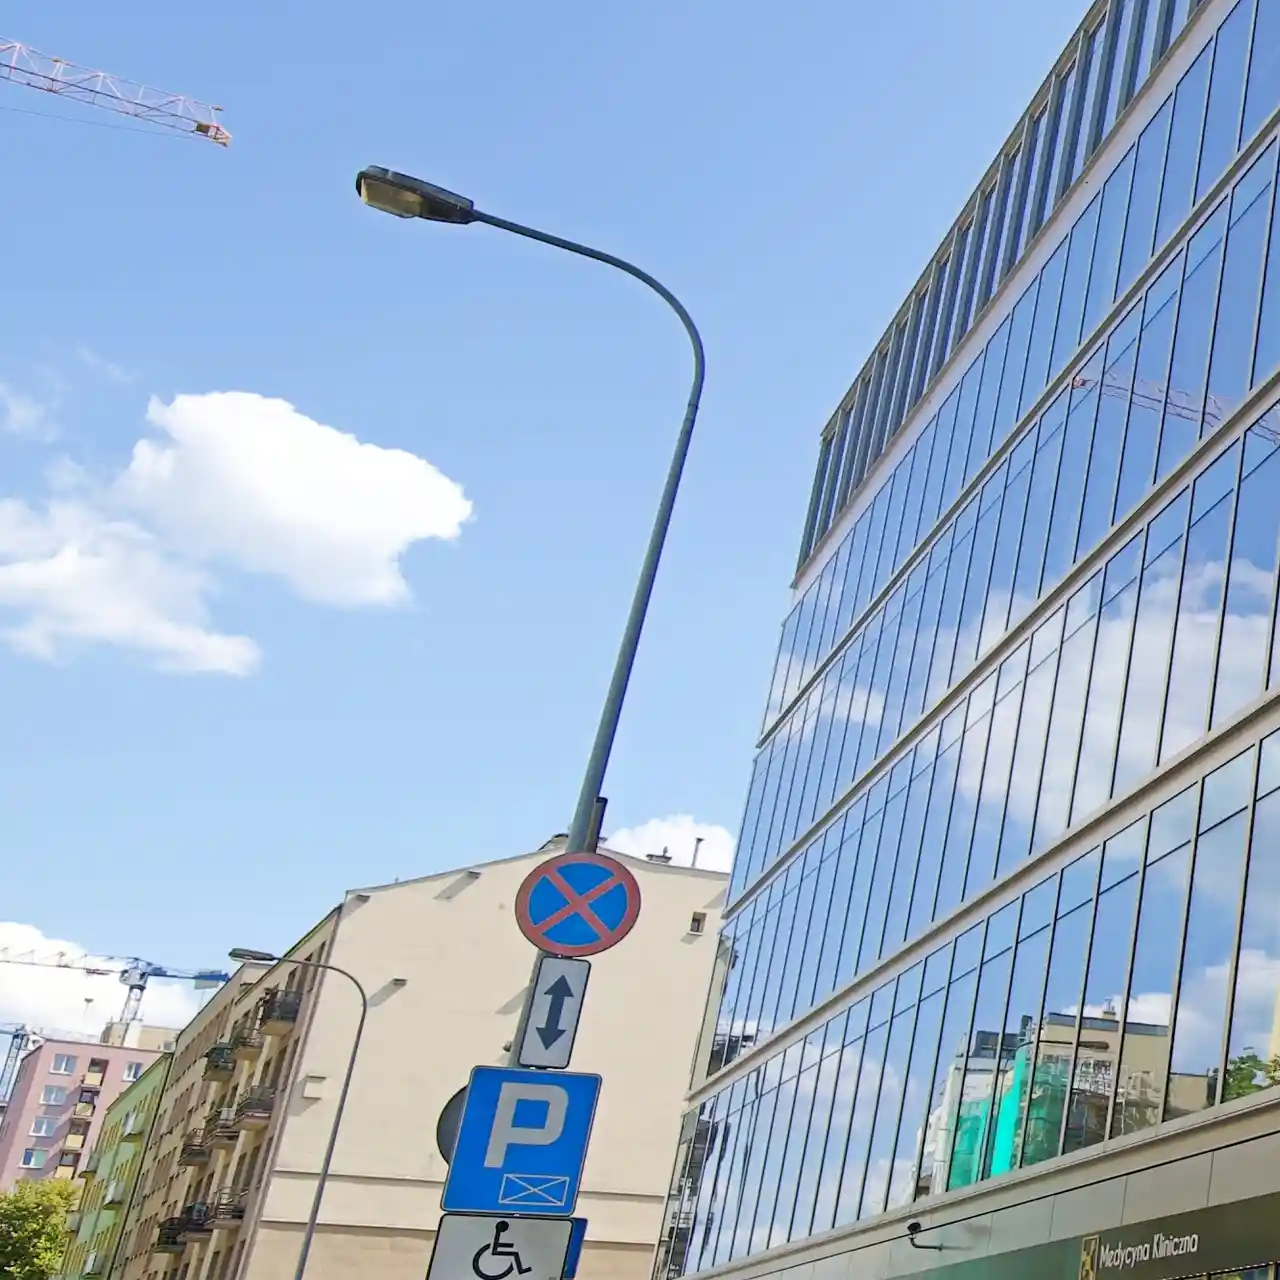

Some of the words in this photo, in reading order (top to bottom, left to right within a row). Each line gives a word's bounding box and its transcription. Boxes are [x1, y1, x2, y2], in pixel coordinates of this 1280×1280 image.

[483, 1081, 569, 1168] P
[1099, 1241, 1151, 1271] Medycyna
[1151, 1232, 1199, 1260] Kliniczna
